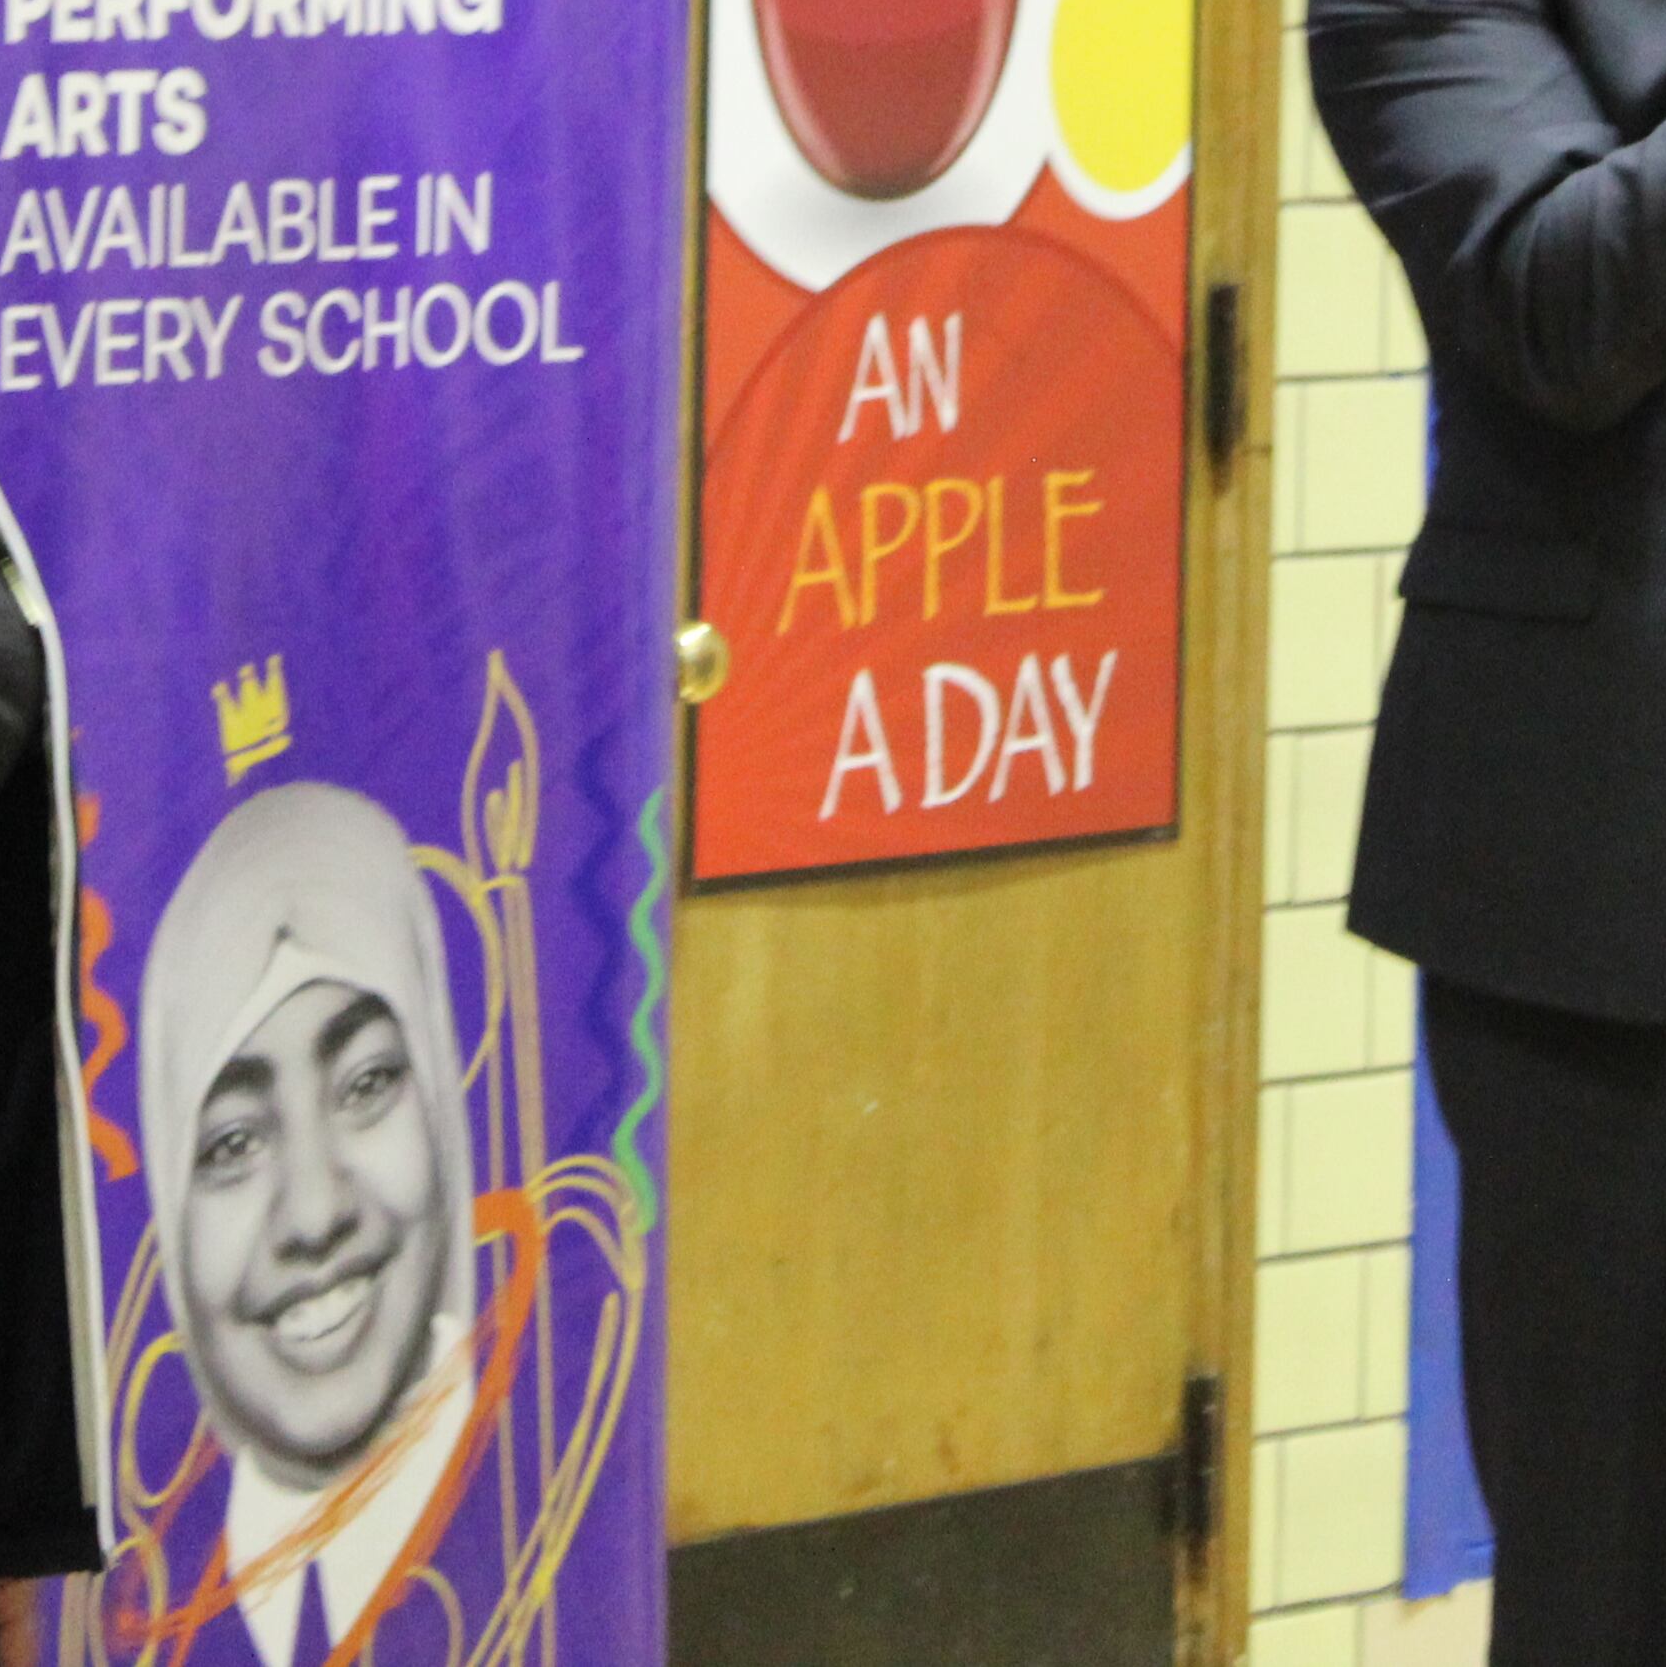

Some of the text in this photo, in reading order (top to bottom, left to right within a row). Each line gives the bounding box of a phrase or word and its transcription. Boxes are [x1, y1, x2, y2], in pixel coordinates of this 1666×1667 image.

[414, 170, 495, 260] IN
[256, 279, 586, 380] SCHOOL
[837, 311, 964, 445] AN
[774, 467, 1108, 639] APPLE
[818, 649, 1119, 822] A DAY
